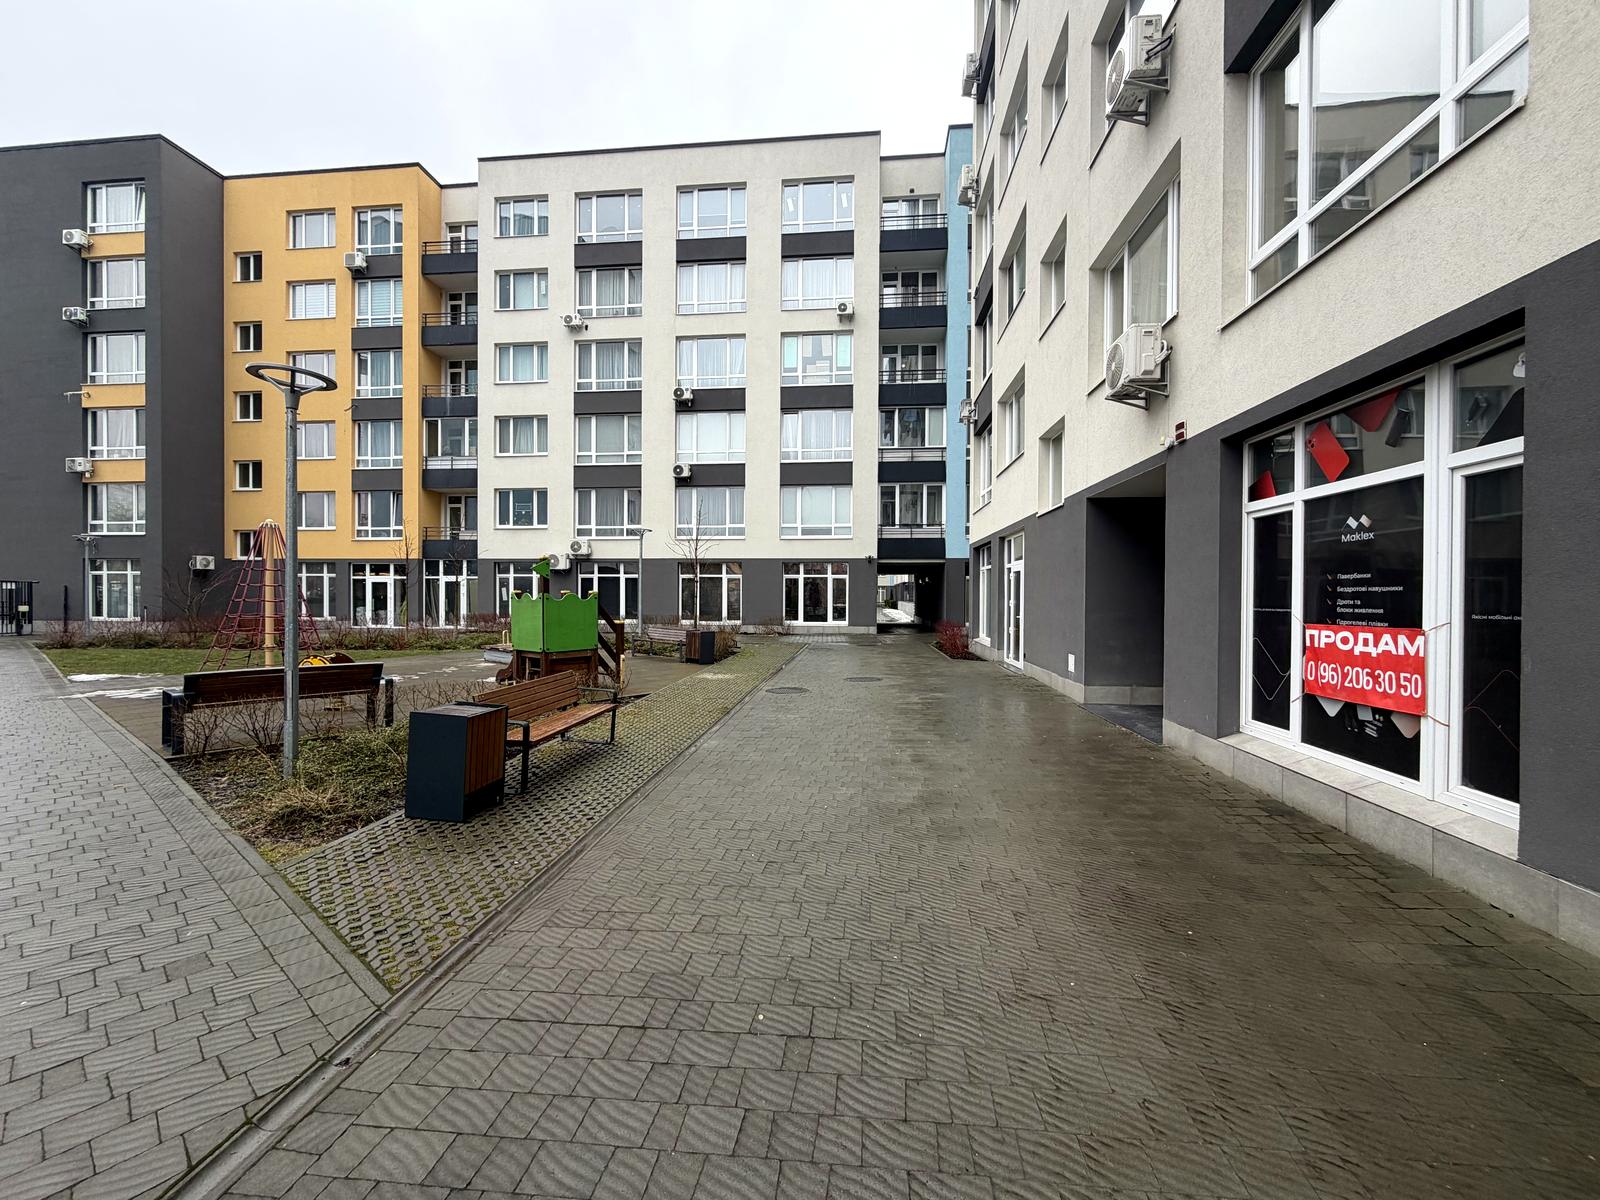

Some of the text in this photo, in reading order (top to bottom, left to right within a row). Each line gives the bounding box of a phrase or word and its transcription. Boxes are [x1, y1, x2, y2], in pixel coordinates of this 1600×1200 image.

[1341, 531, 1374, 543] Maklex
[1306, 629, 1425, 657] ПРОДАМ
[1307, 660, 1422, 698] 0 (96) 206 30 50
